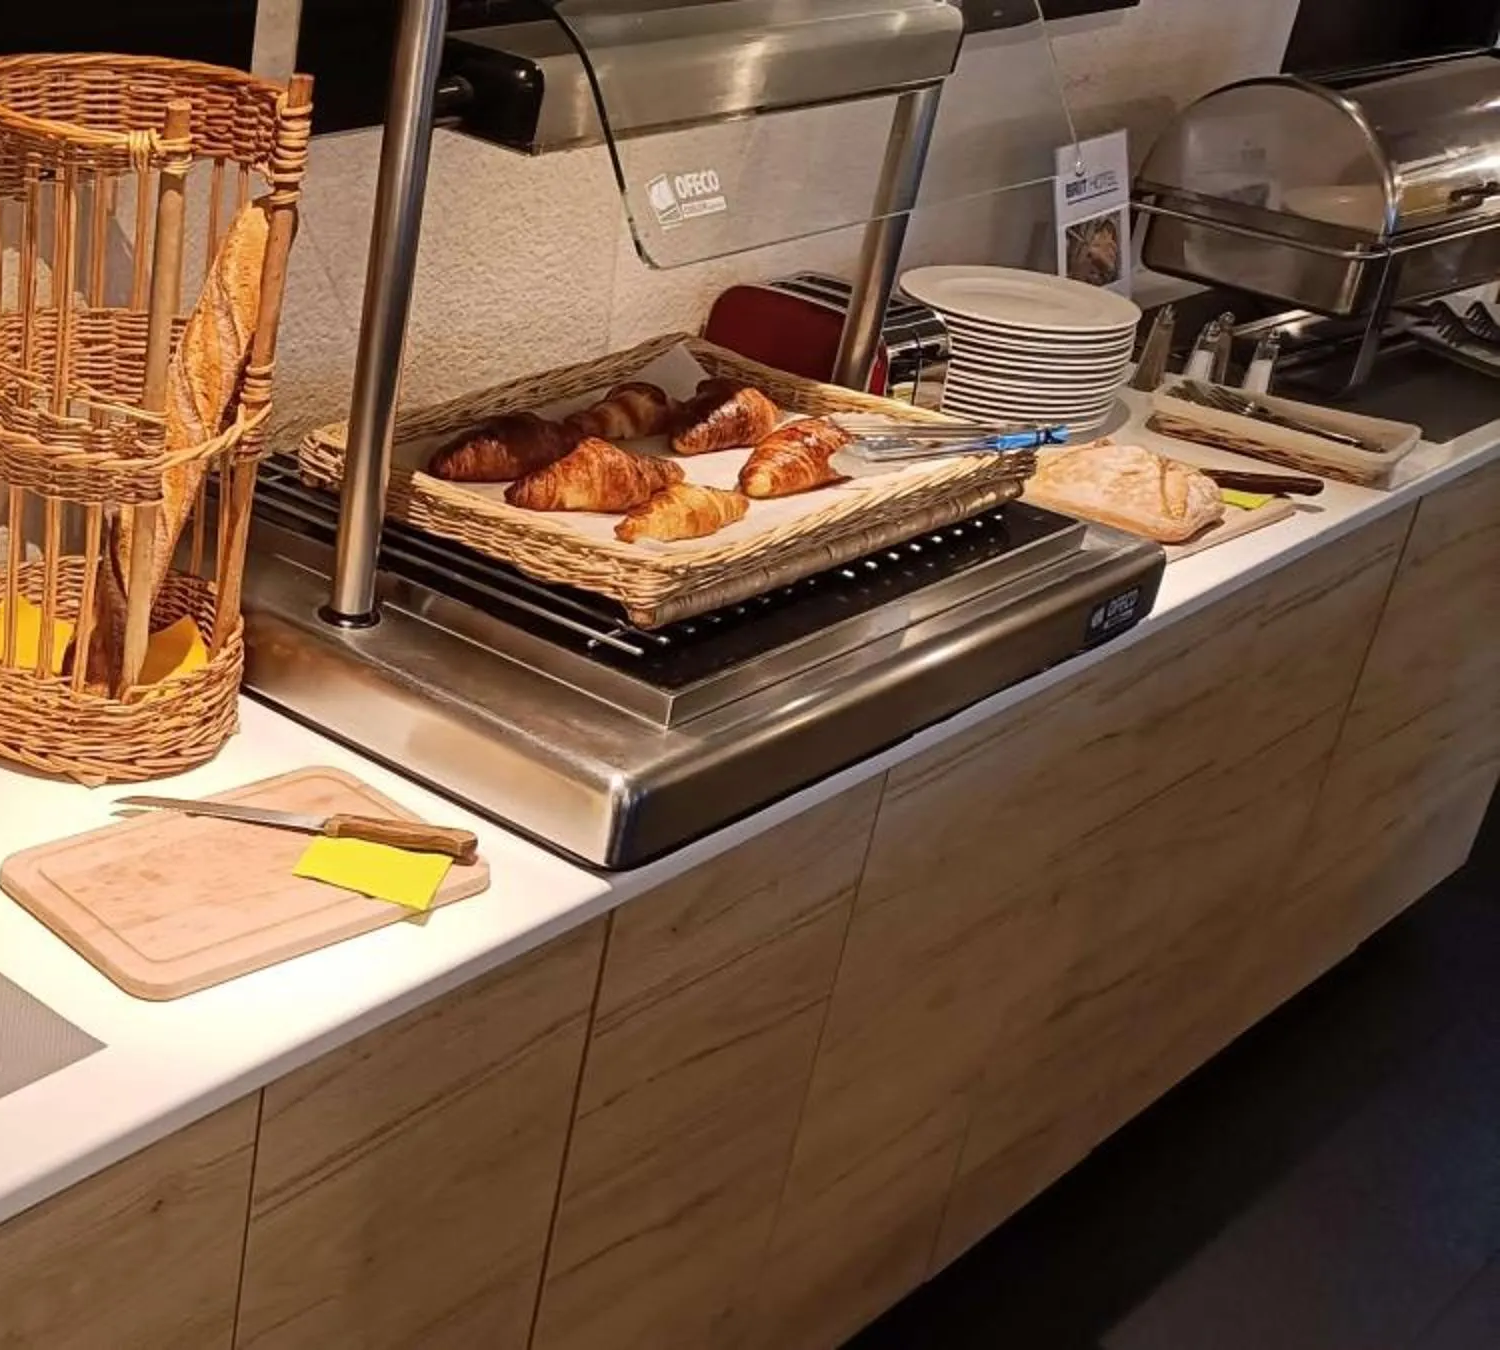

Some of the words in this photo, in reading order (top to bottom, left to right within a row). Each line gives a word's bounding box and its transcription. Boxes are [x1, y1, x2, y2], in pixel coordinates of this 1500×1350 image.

[675, 169, 720, 199] OFECO
[1066, 178, 1087, 198] BRIT
[1089, 170, 1118, 190] HOTEL
